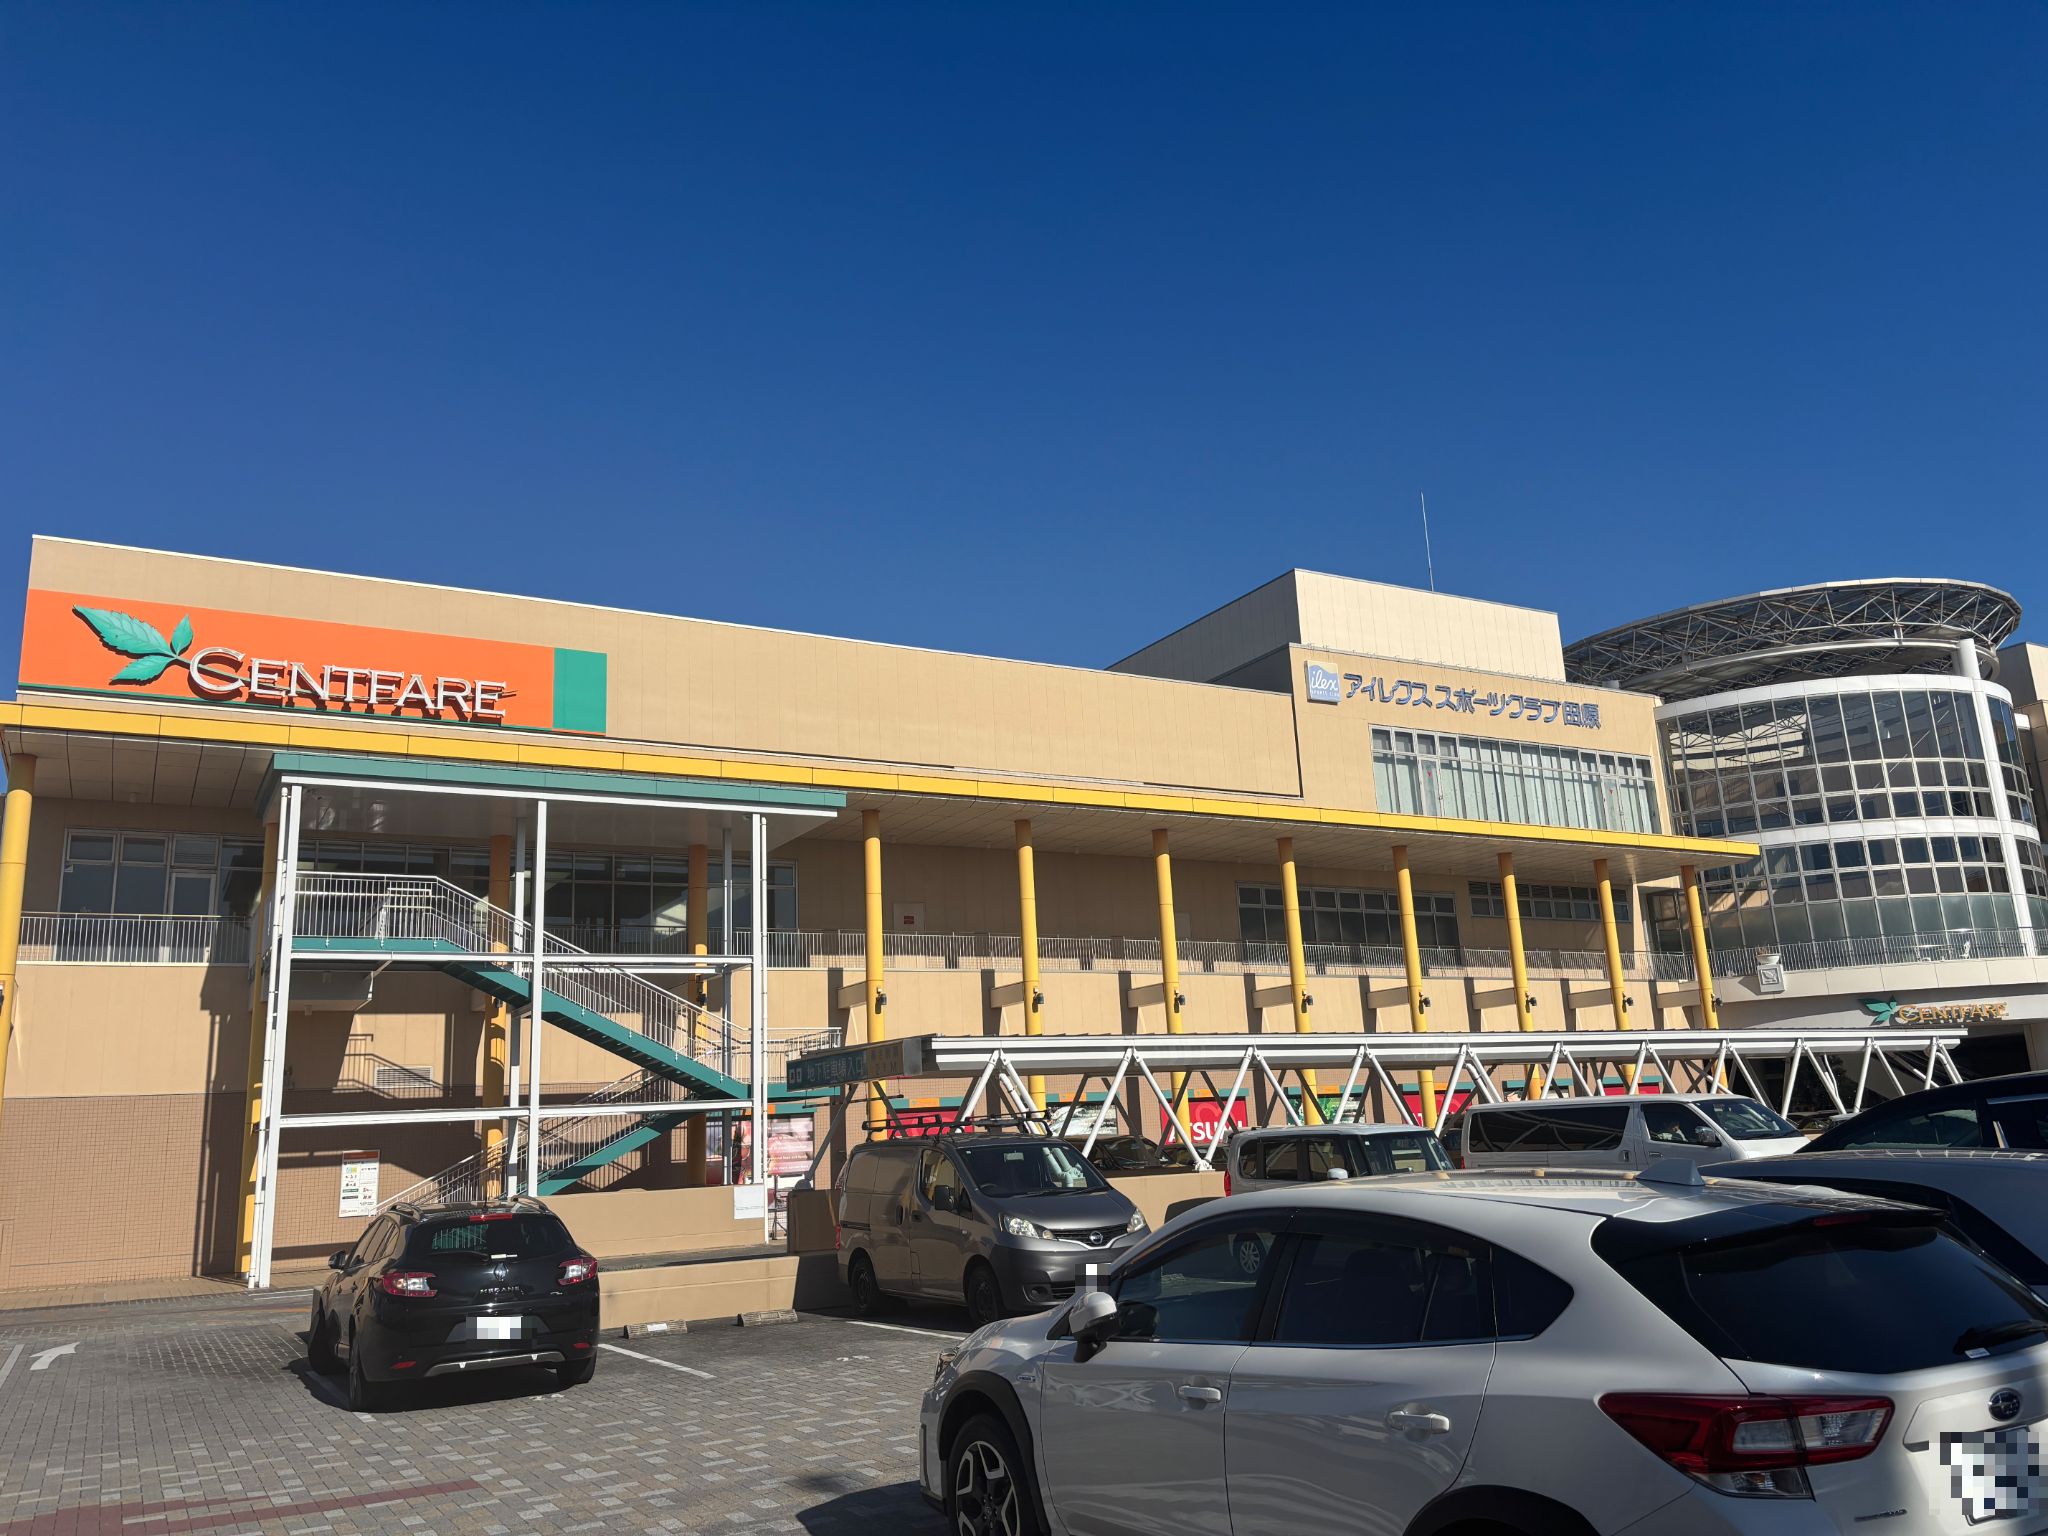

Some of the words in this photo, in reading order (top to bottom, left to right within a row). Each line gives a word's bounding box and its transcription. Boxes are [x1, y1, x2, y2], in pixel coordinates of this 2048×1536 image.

[189, 646, 507, 716] CENTFARE
[1311, 669, 1338, 691] ilex
[1899, 1002, 2009, 1022] CENTFARE
[1168, 1120, 1243, 1142] ASU
